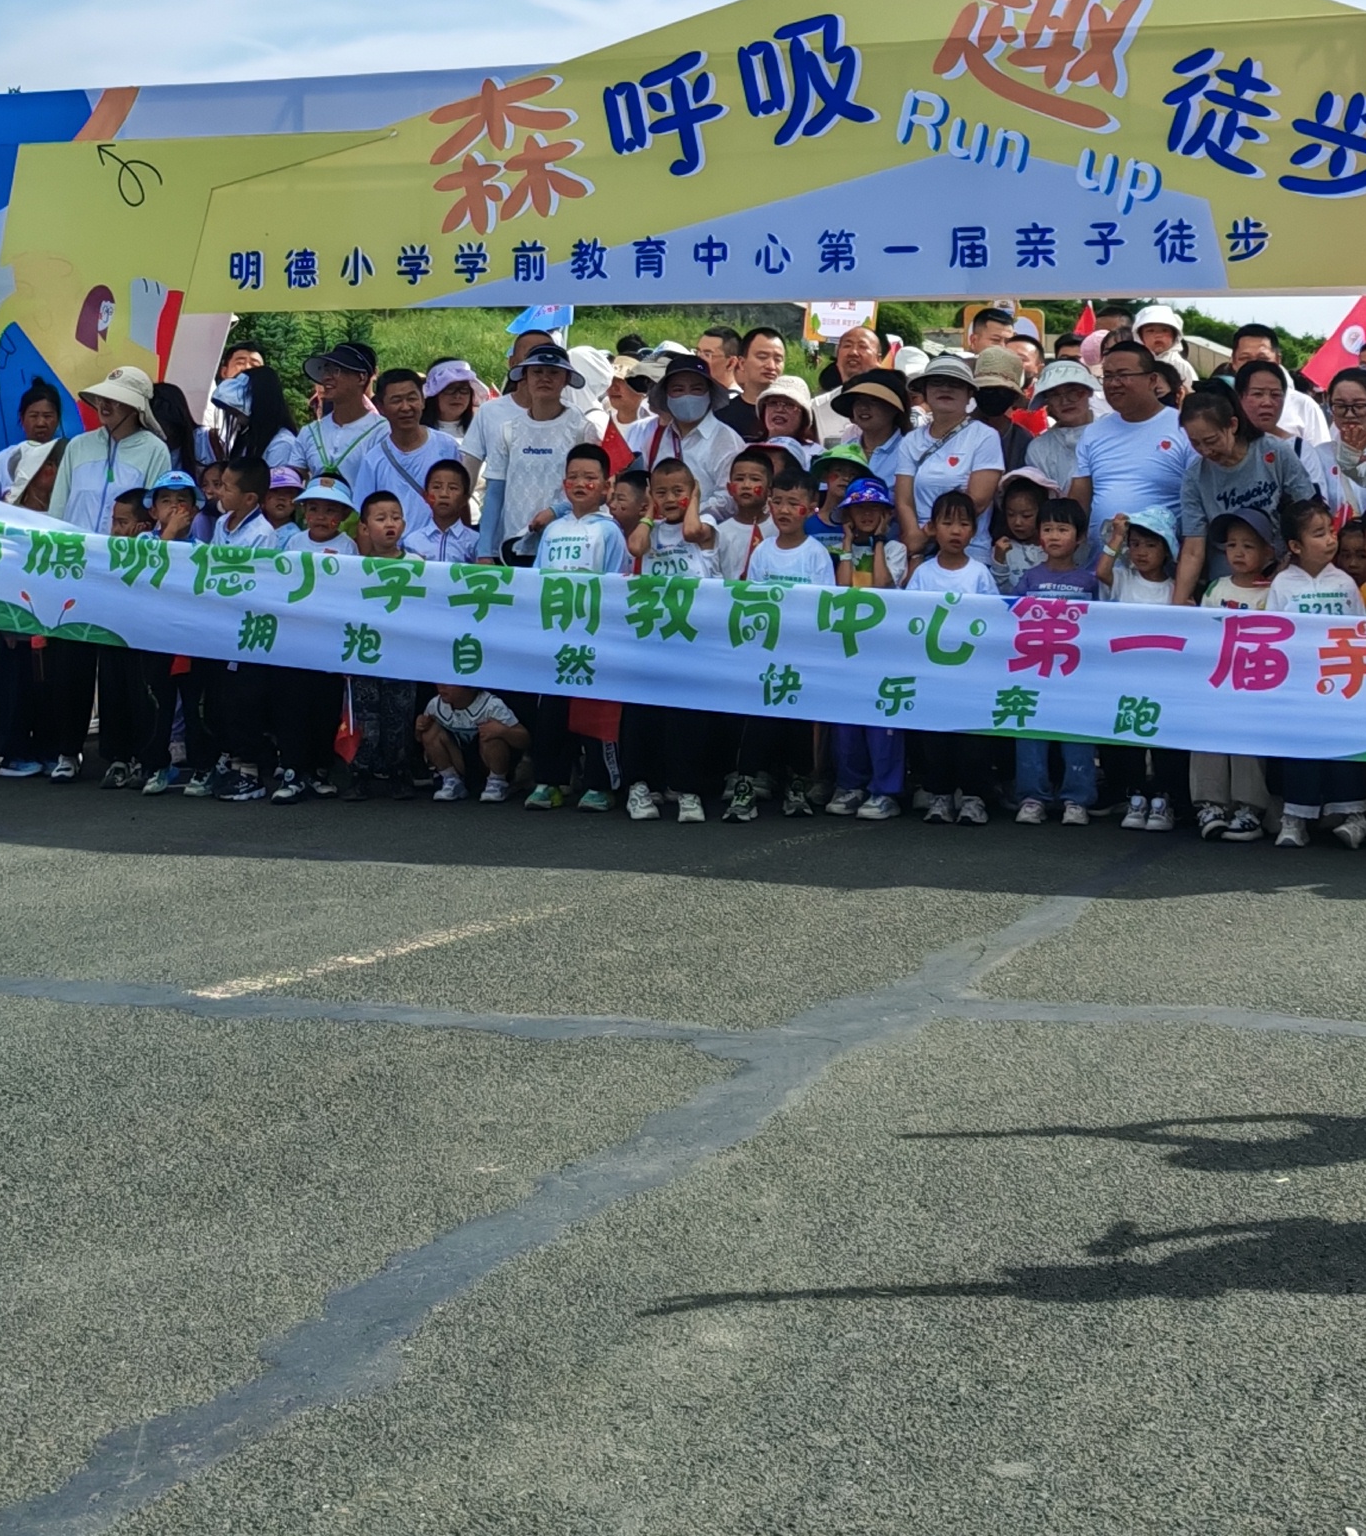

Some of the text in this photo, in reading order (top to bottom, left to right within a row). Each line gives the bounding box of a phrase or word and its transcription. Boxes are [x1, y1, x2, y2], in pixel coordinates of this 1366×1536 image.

[896, 89, 1164, 216] Run up
[228, 214, 1272, 291] 明德小学学前教育中心第一届亲子徒步
[548, 545, 582, 563] C113
[651, 557, 689, 576] C110
[1298, 602, 1344, 616] B213
[237, 610, 1162, 738] 拥抱自然 快乐奔跑
